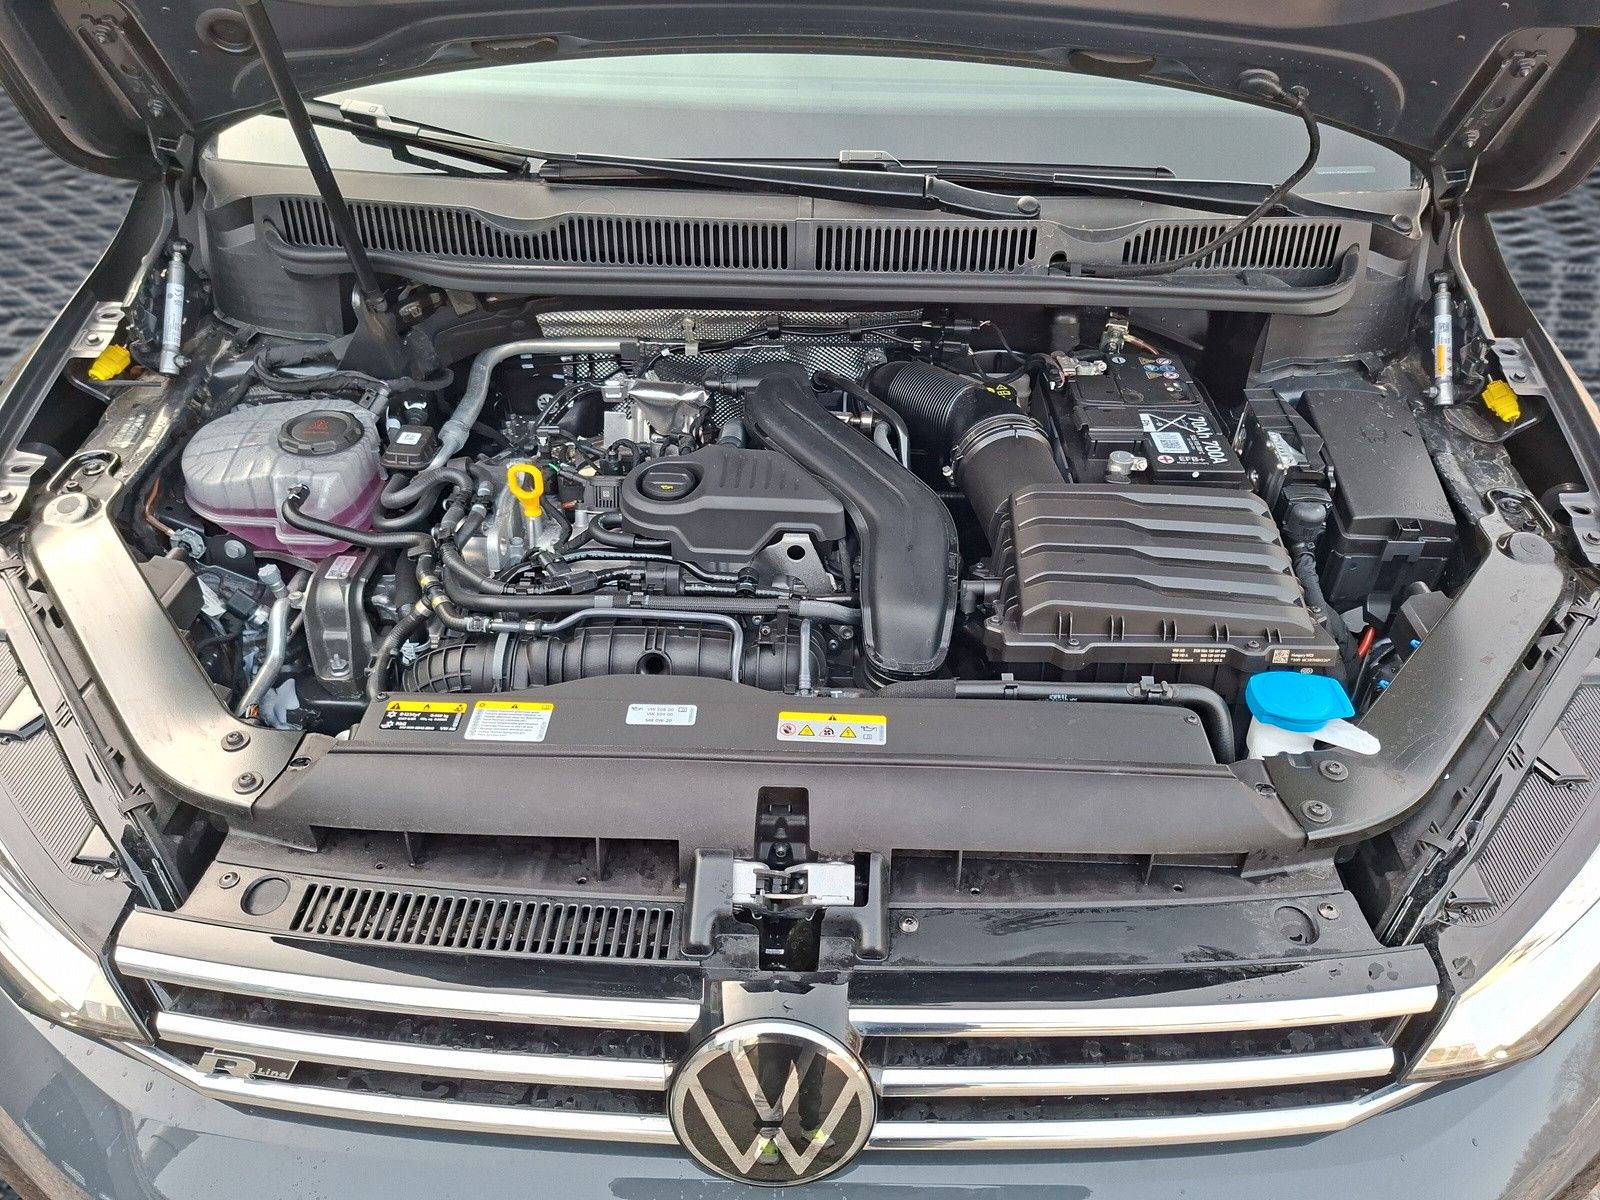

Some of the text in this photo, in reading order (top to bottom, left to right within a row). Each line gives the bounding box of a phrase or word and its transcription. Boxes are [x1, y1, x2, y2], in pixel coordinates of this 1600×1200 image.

[1187, 416, 1214, 439] 70Ah
[1201, 440, 1229, 464] 700A
[197, 1052, 288, 1080] R Line
[680, 1036, 866, 1178] VW
